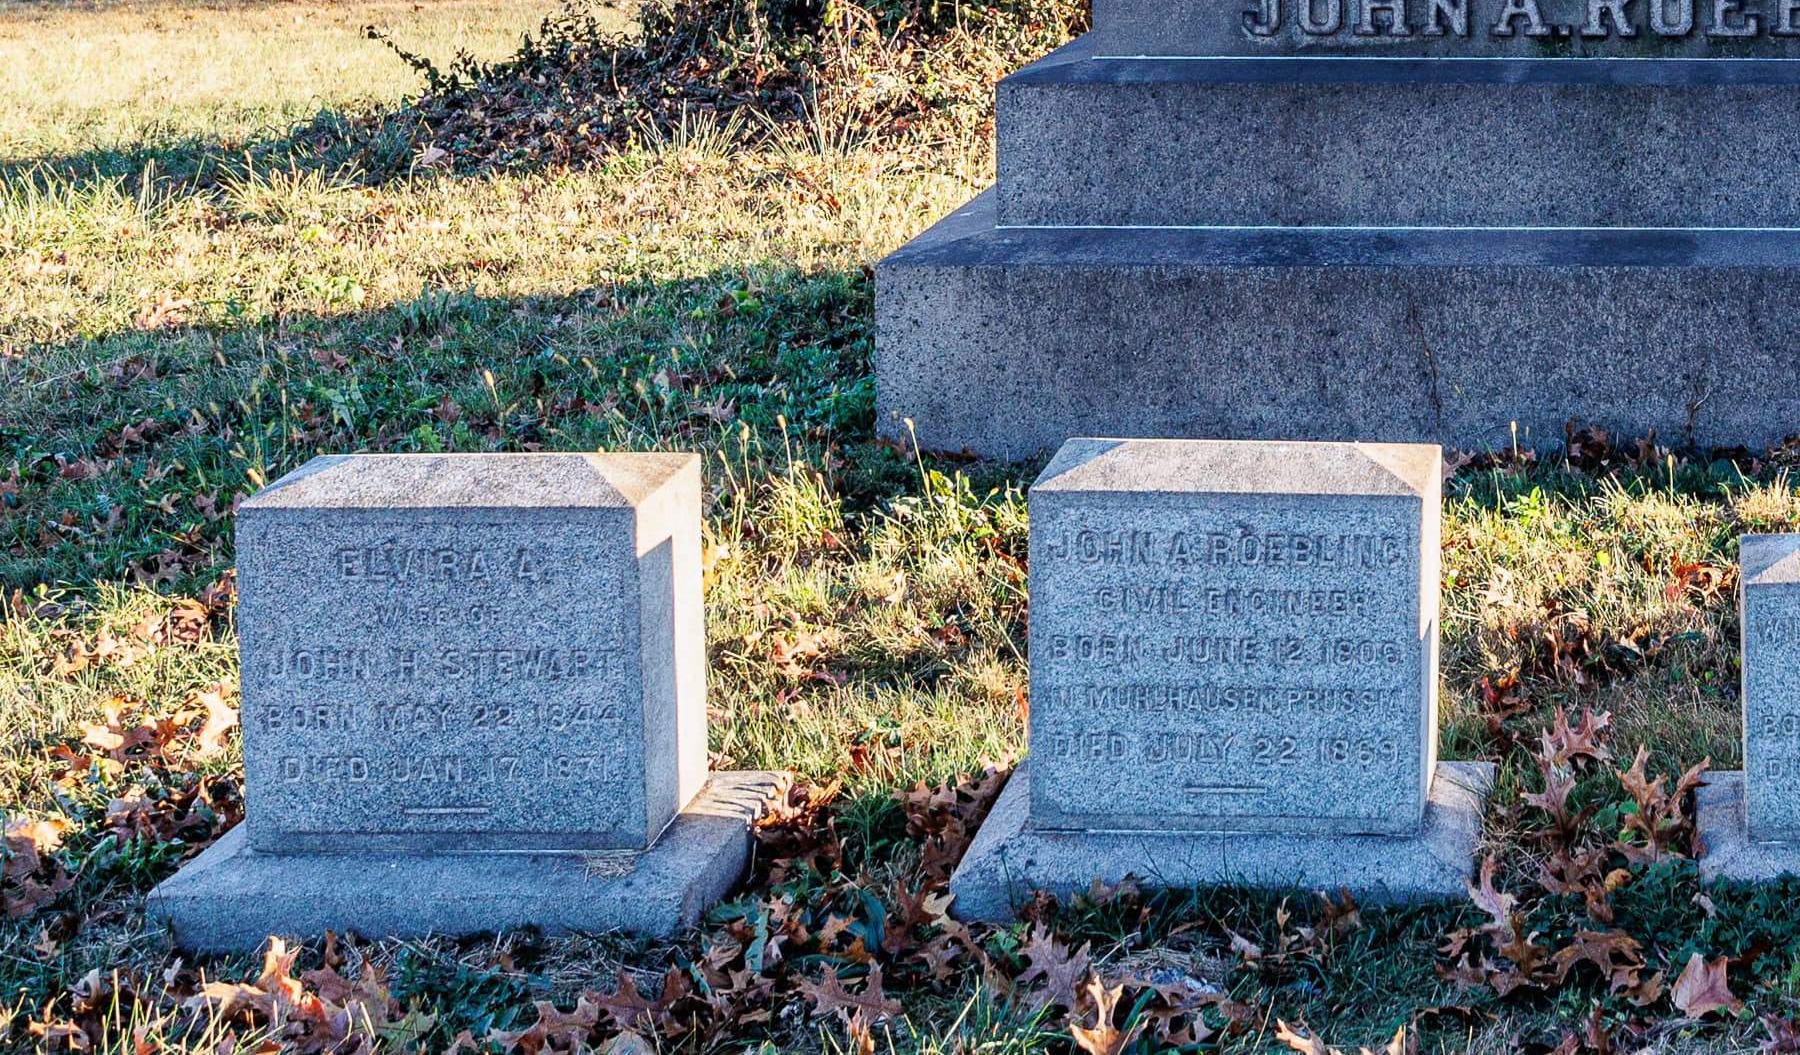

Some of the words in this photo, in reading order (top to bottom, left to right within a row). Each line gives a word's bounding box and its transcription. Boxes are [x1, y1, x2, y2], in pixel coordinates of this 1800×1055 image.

[338, 546, 492, 583] ELVIRA
[1047, 529, 1151, 568] JOHN
[1205, 530, 1403, 572] ROEBLING
[1096, 584, 1192, 615] CIVIL
[268, 649, 371, 683] JOHN
[262, 703, 355, 733] BORN
[1147, 731, 1238, 766] JULY
